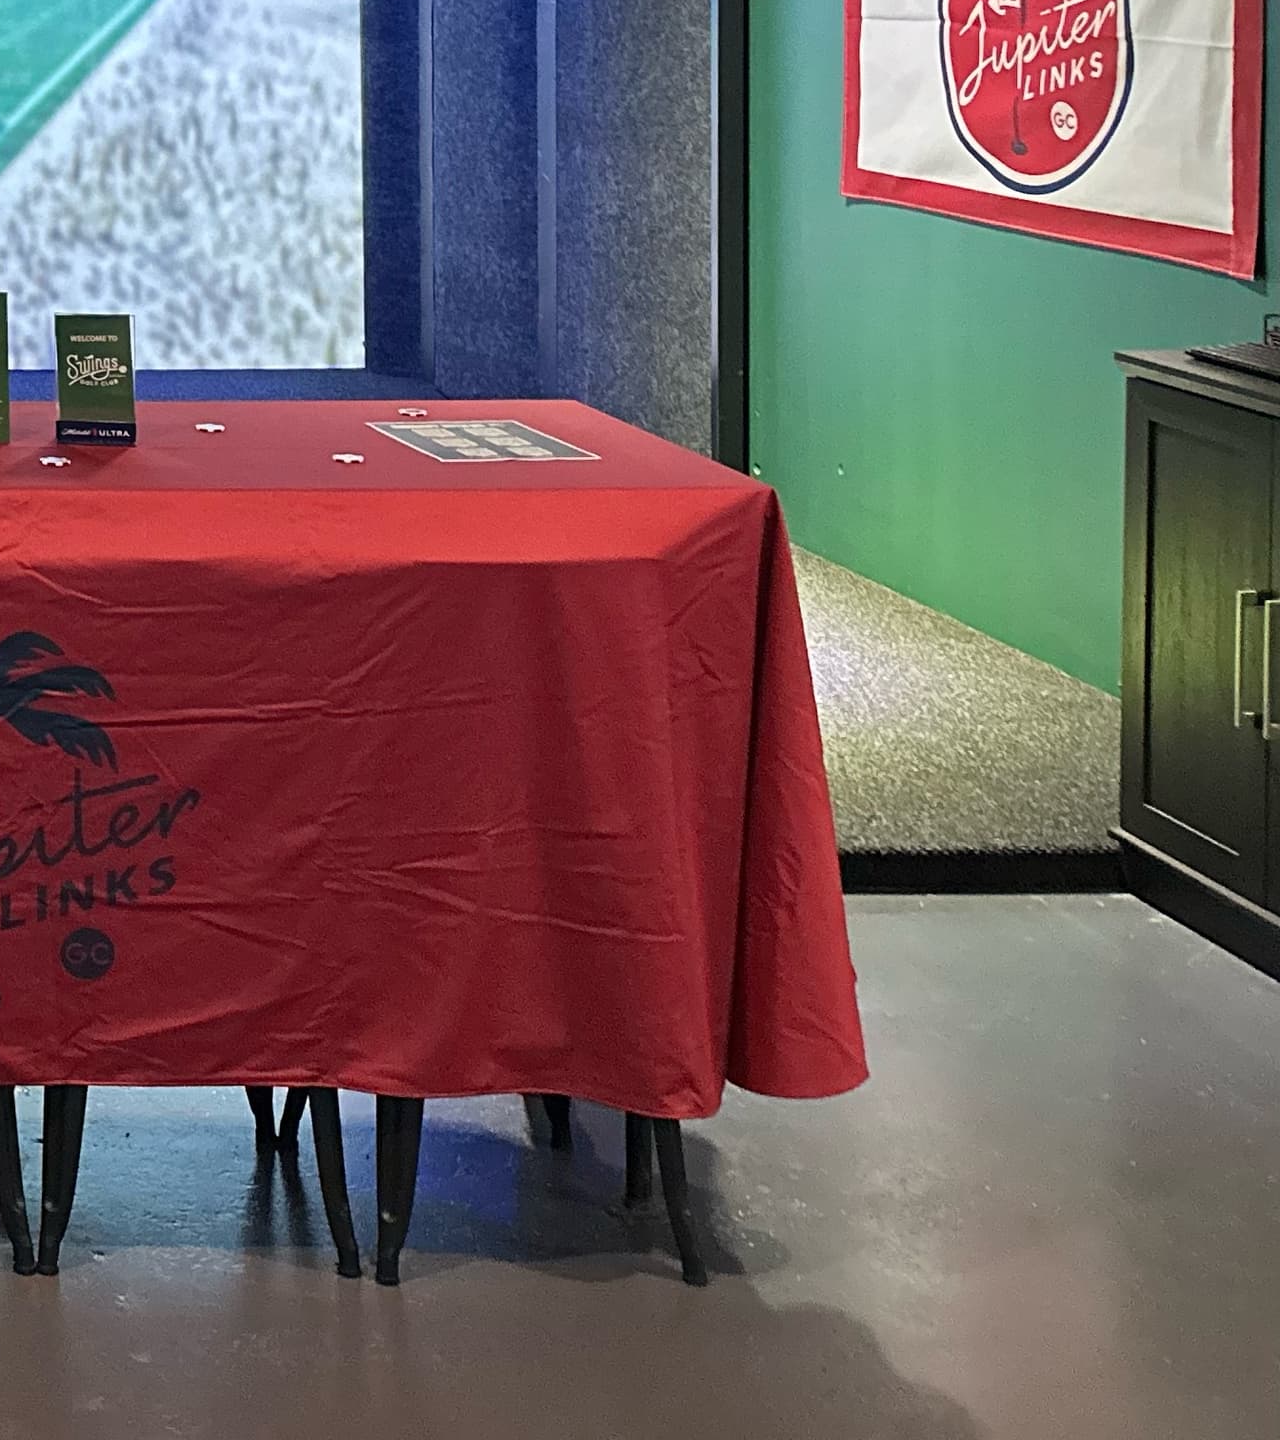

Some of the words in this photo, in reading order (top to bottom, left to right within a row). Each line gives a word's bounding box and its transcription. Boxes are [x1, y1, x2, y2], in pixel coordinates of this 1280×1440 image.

[1022, 51, 1104, 101] LINKS
[1053, 112, 1075, 130] GC
[69, 334, 107, 342] WELCOME
[107, 334, 118, 342] TO
[66, 354, 120, 387] Swings
[98, 429, 131, 438] ULTRA
[0, 856, 177, 930] LINKS
[65, 942, 112, 965] GC
